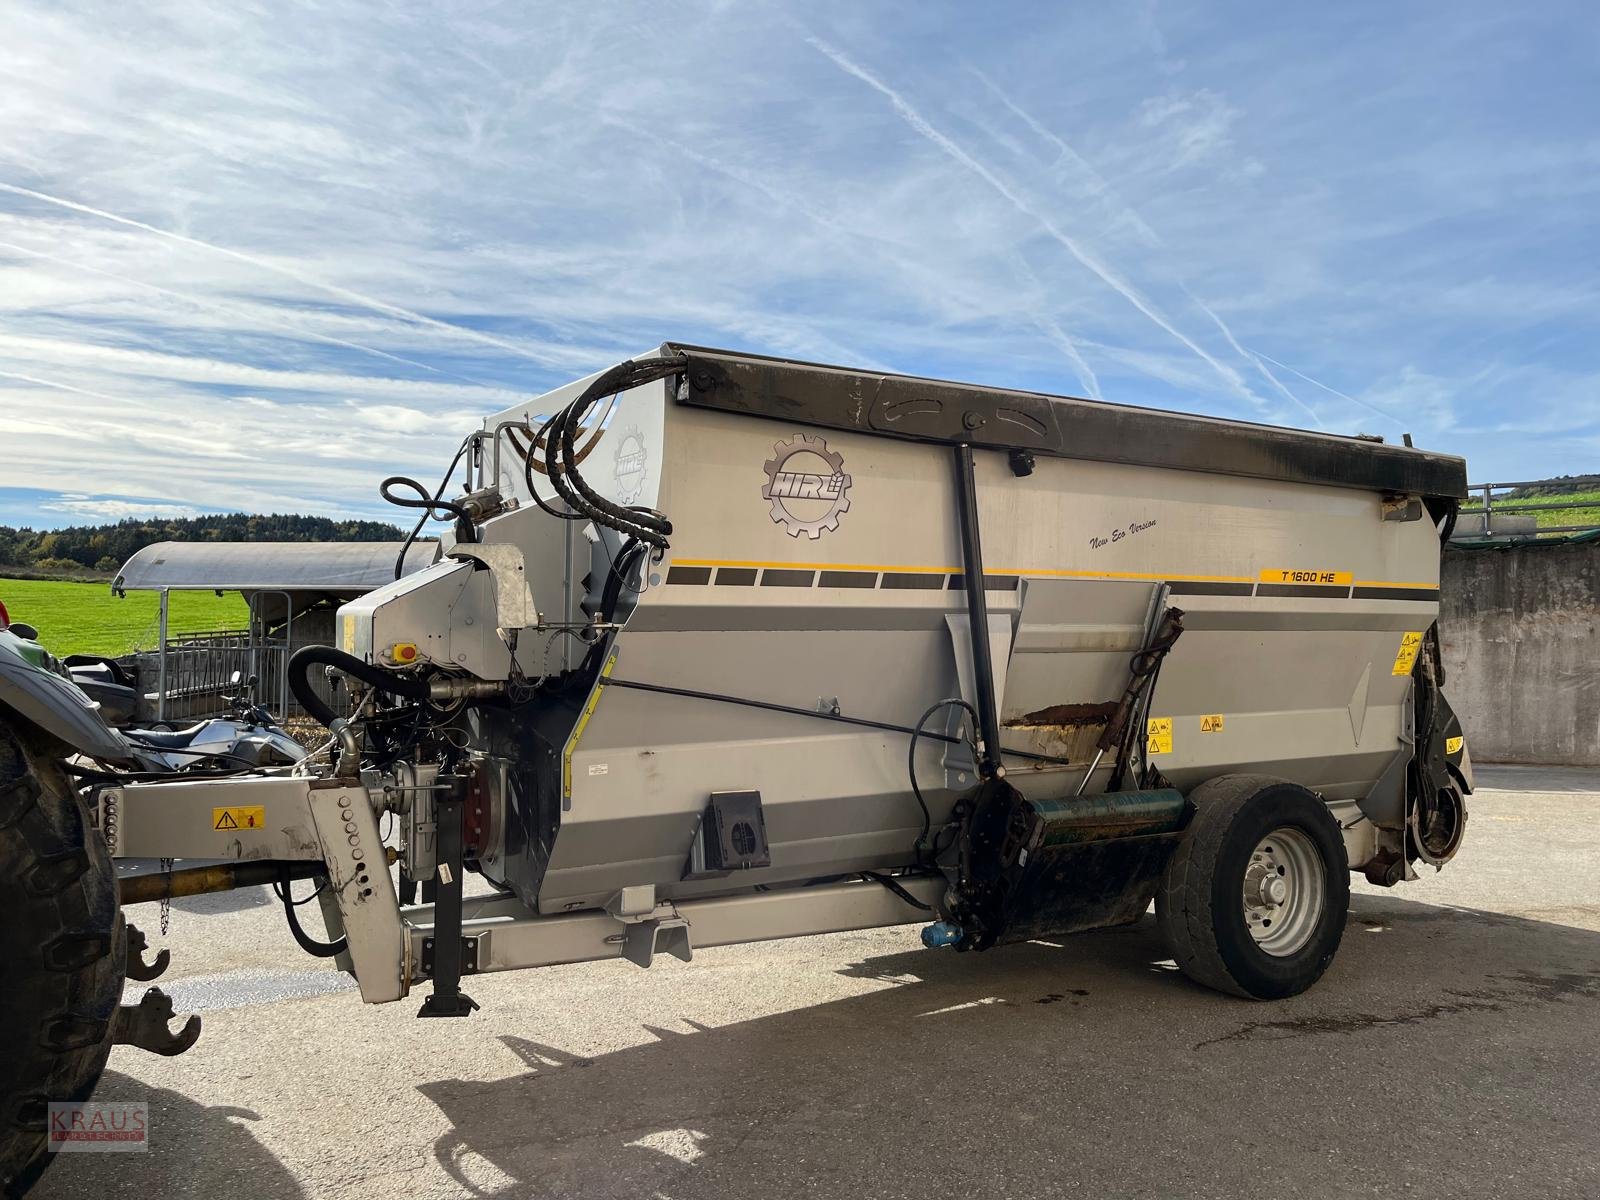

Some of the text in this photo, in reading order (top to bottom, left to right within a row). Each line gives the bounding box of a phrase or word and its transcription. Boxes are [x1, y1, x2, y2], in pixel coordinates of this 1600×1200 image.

[769, 471, 845, 500] HIRL
[1089, 519, 1156, 549] New Eco Version
[1282, 571, 1335, 583] T 1600 HE
